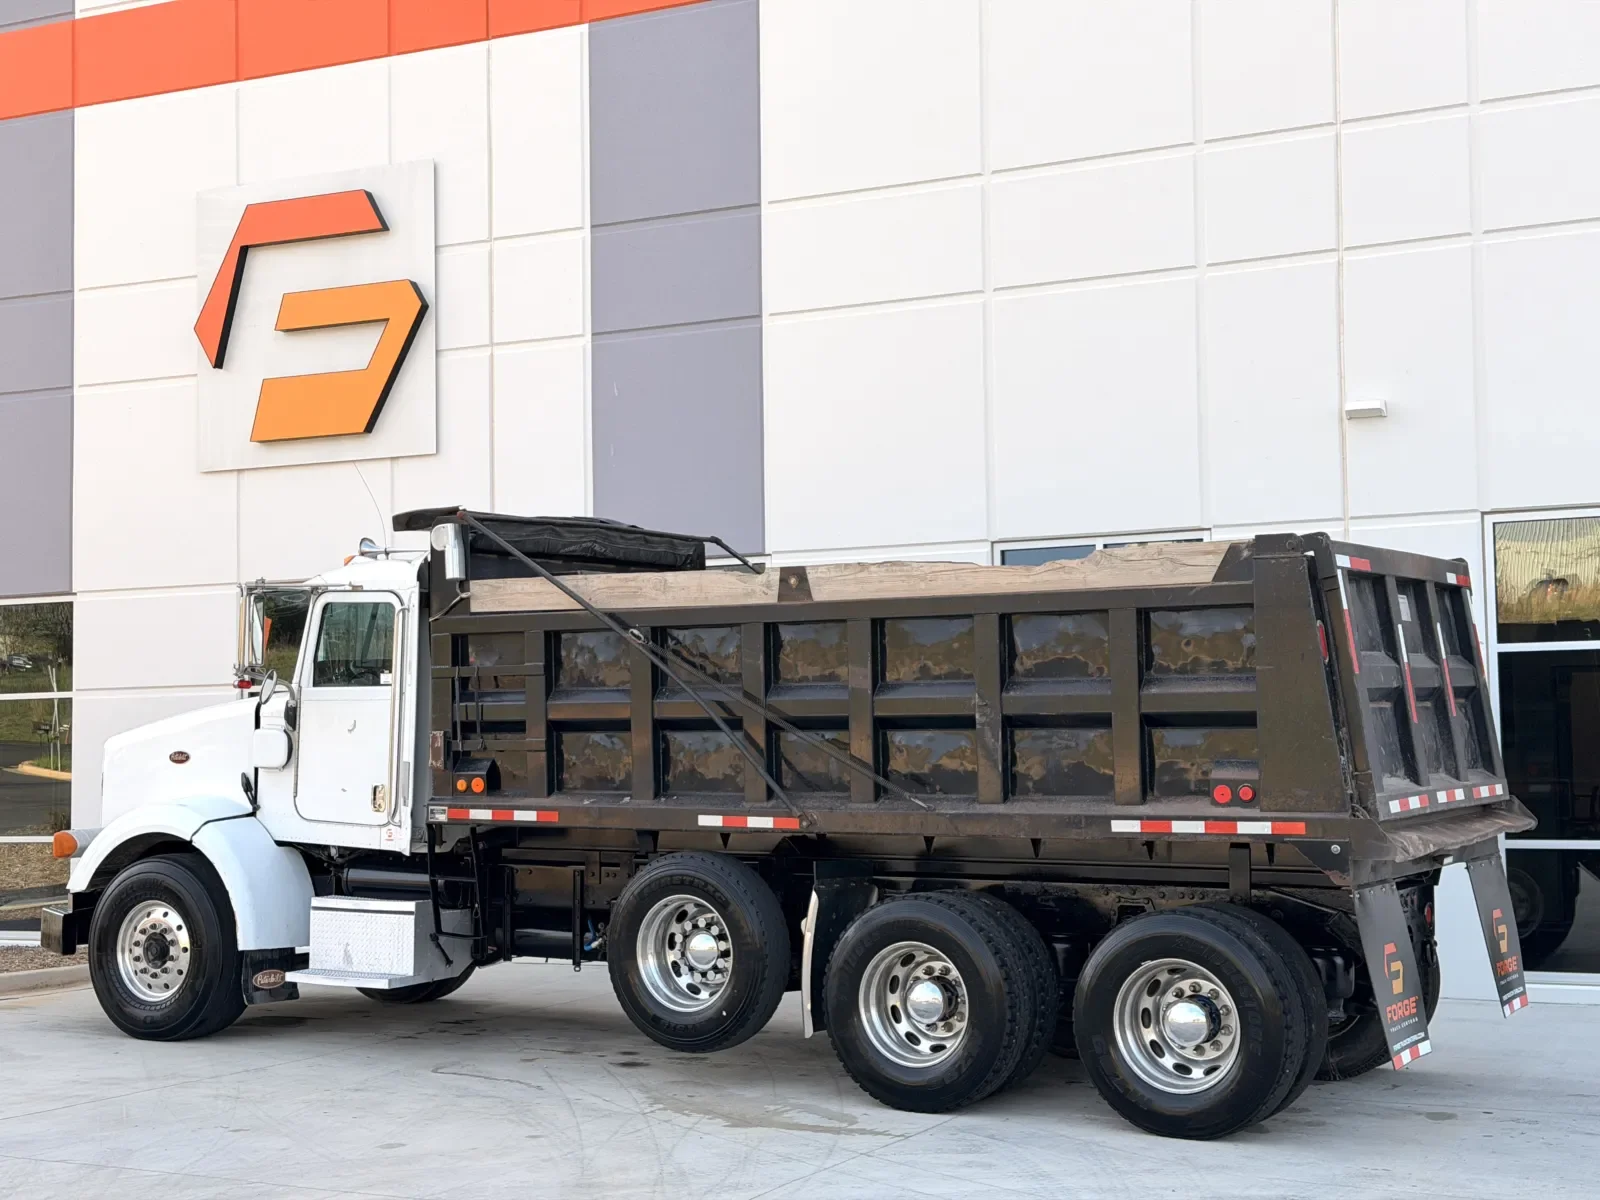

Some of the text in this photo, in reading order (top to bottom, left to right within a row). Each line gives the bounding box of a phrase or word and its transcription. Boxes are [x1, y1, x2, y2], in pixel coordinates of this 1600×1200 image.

[1496, 956, 1518, 976] FORGE
[257, 973, 284, 986] Peterbilt
[1386, 996, 1417, 1024] FORGE
